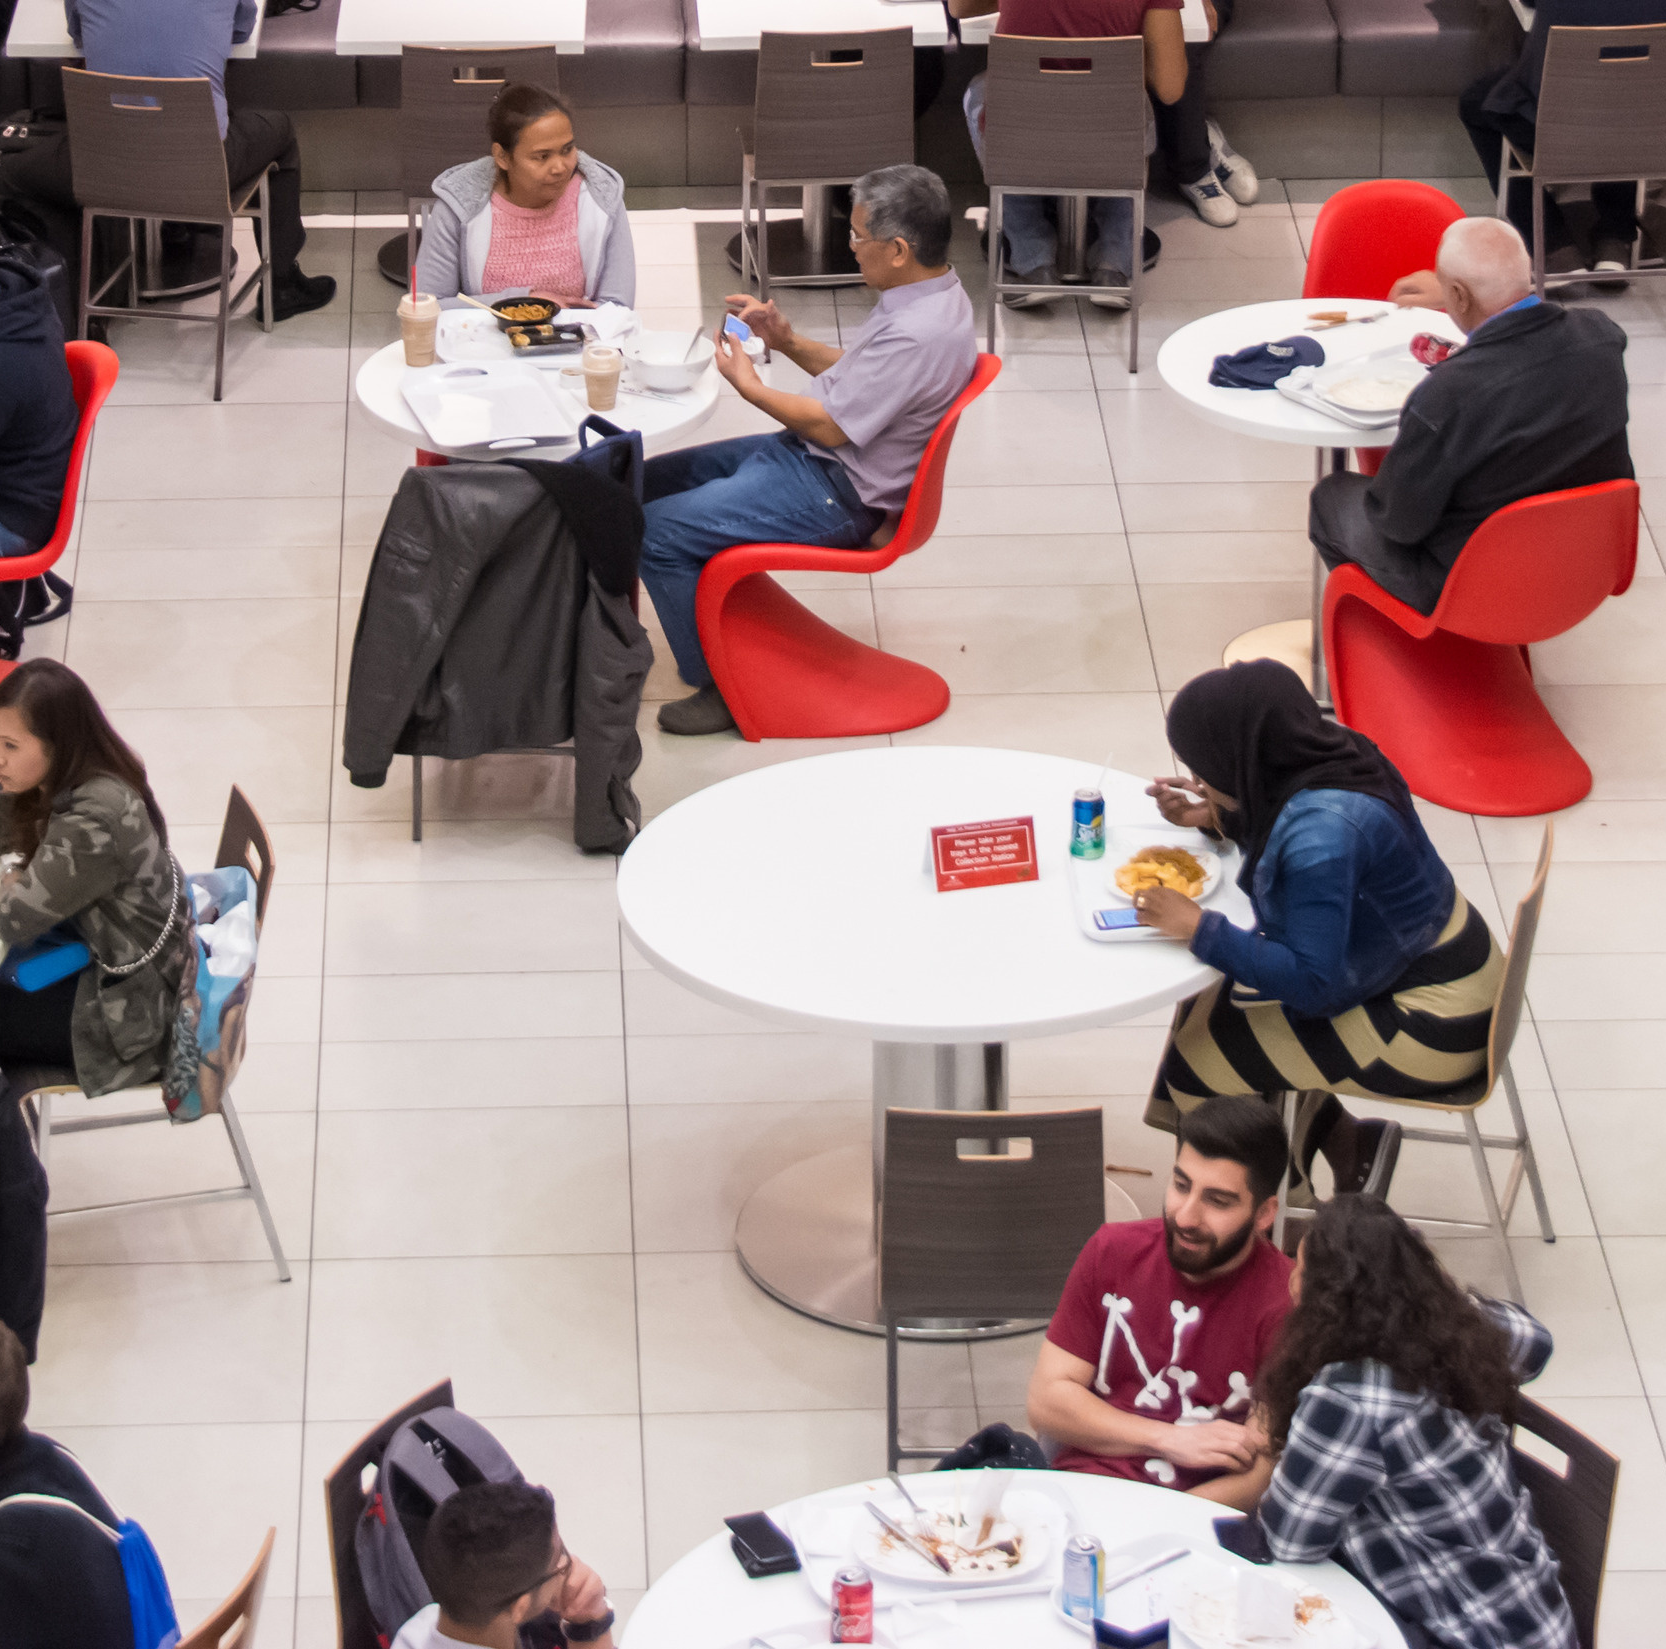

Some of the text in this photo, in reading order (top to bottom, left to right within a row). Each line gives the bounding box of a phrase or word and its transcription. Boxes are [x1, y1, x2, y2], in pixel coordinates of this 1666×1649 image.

[954, 834, 1012, 847] Please take your
[950, 849, 967, 857] trays
[993, 842, 1019, 851] nearest
[955, 853, 1016, 866] Collection Station
